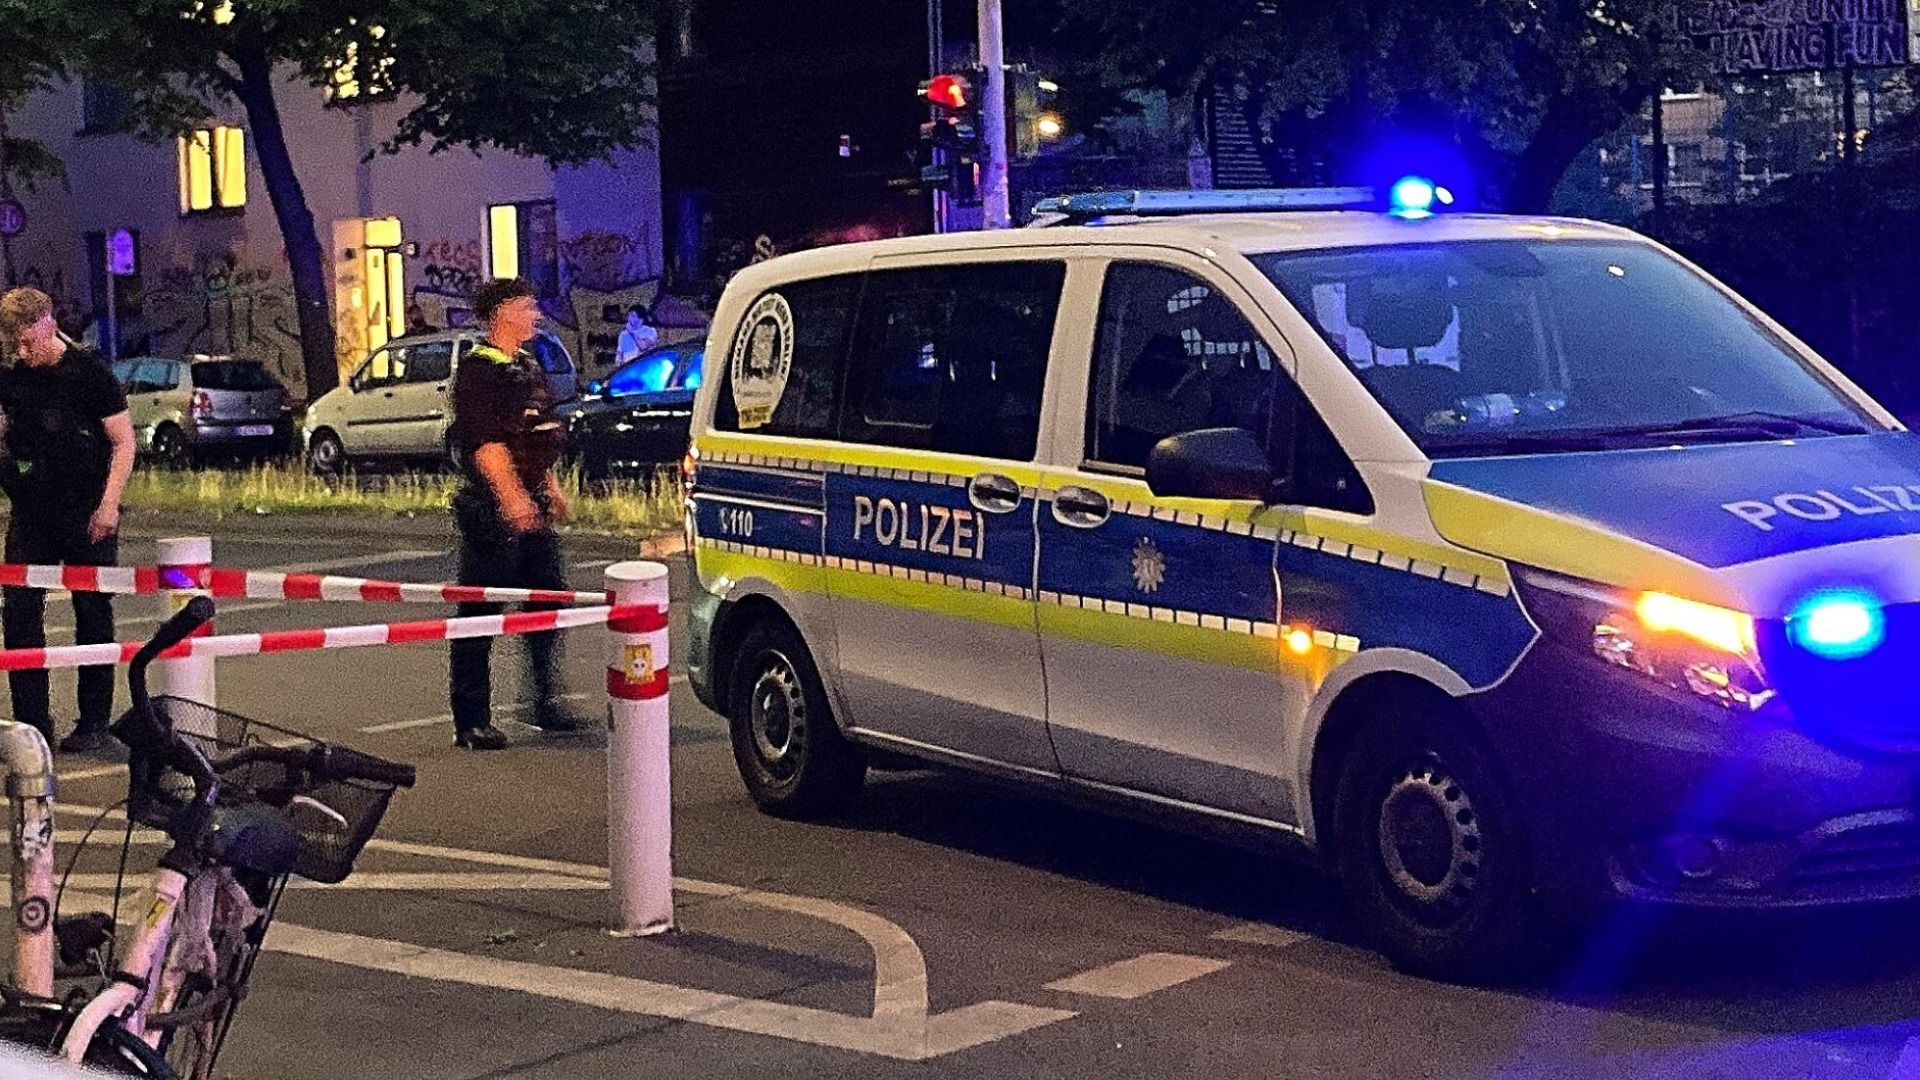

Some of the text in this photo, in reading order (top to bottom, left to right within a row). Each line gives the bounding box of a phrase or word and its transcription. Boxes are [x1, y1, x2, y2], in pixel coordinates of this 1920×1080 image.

[1832, 22, 1906, 68] FUN
[729, 508, 753, 537] 110
[853, 496, 985, 560] POLIZEI
[1721, 485, 1920, 532] POLIZ
